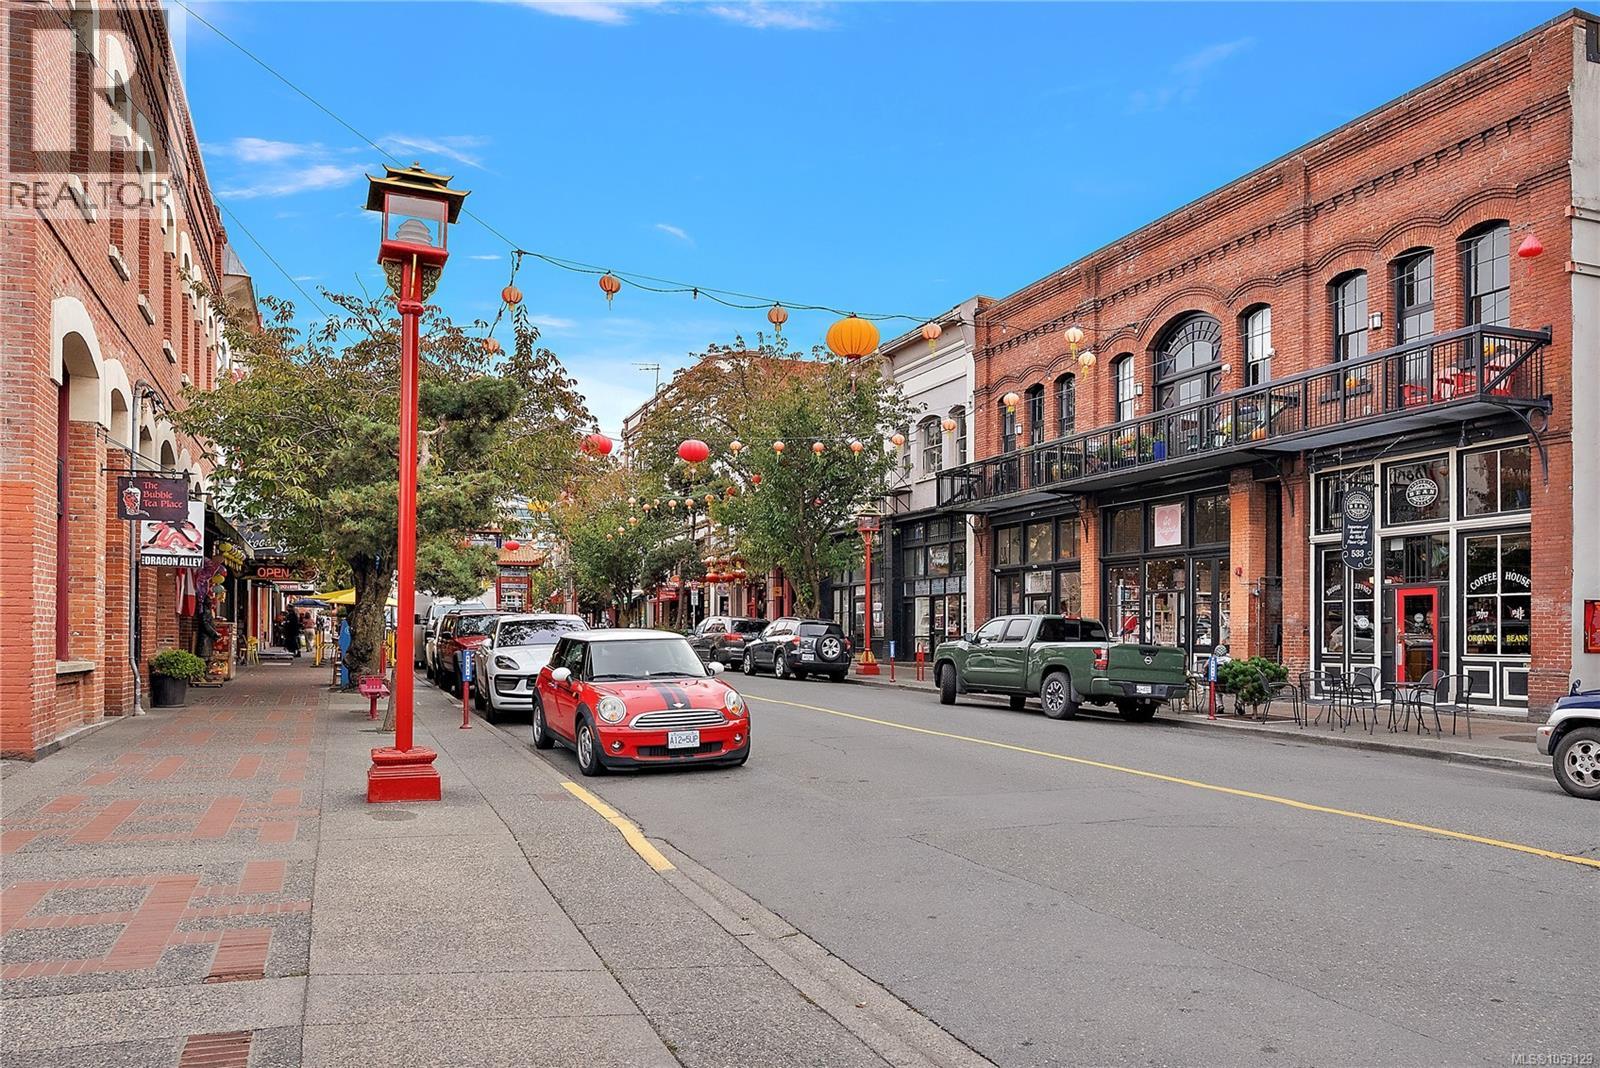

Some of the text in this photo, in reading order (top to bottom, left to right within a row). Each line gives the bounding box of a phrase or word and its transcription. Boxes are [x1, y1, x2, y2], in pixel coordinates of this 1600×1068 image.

[143, 481, 159, 489] The
[143, 491, 173, 499] Bubble
[160, 500, 183, 508] Place
[1351, 549, 1365, 558] 533
[145, 556, 179, 566] DRAGON
[179, 557, 202, 567] ALLEY
[257, 567, 290, 578] OPEN
[1470, 571, 1531, 590] COFFEE HOUSE
[1467, 634, 1528, 642] ORGANIC BEANS
